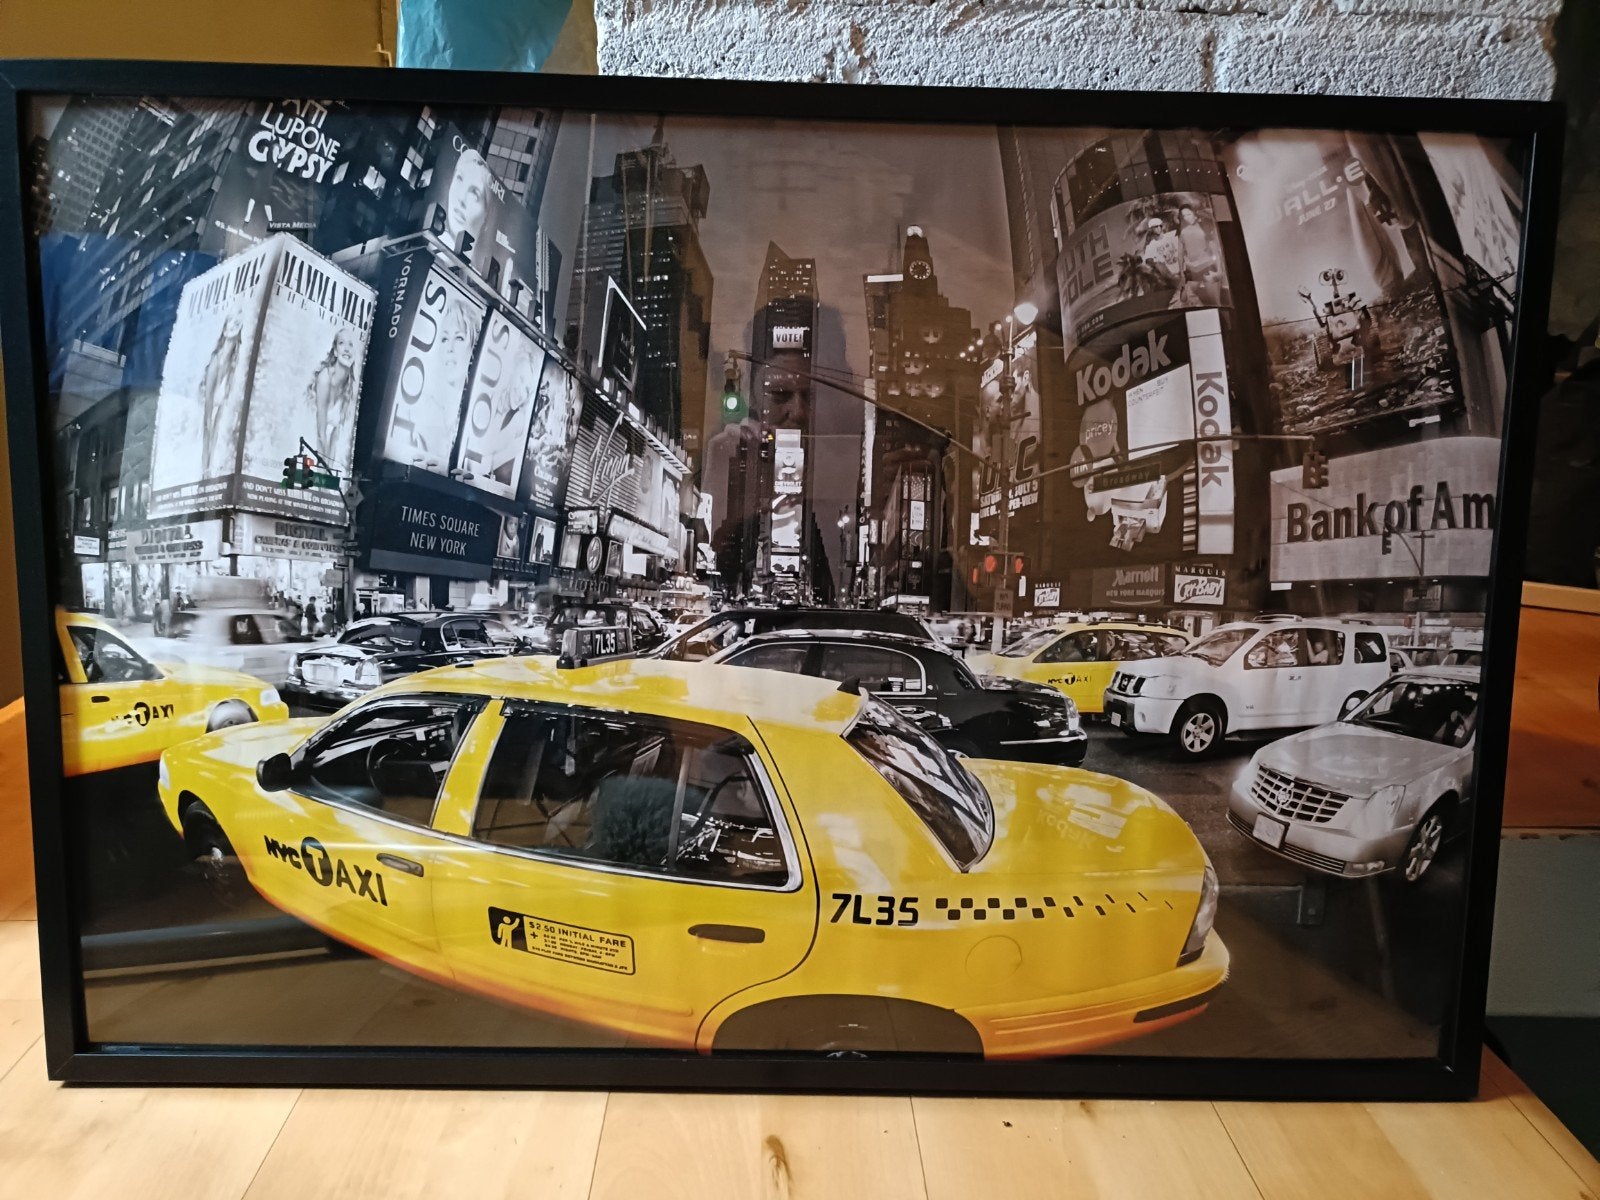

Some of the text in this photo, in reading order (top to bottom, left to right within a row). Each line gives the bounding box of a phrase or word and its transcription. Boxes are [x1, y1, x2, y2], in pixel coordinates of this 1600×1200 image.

[260, 102, 341, 160] LUPONE
[249, 130, 333, 183] GYPSY
[388, 253, 413, 338] VORNADO
[391, 280, 447, 439] TOUS
[1076, 329, 1172, 406] Kodak
[461, 318, 510, 470] TOUS
[1085, 420, 1114, 444] pricey
[1195, 371, 1229, 488] Kodak
[1102, 472, 1150, 487] Broadway
[401, 505, 481, 538] TIMES SQUARE
[1287, 480, 1495, 543] Bank of Am
[409, 531, 467, 557] NEW YORK
[1111, 565, 1160, 587] Marriott
[1174, 565, 1227, 577] MARQUIS
[1105, 588, 1165, 598] NEW YORK MARQUIS
[595, 631, 617, 655] 7L35
[264, 835, 388, 907] NYC TAXI
[830, 893, 919, 927] 7L35
[558, 928, 595, 942] INITIAL
[599, 935, 627, 948] FARE
